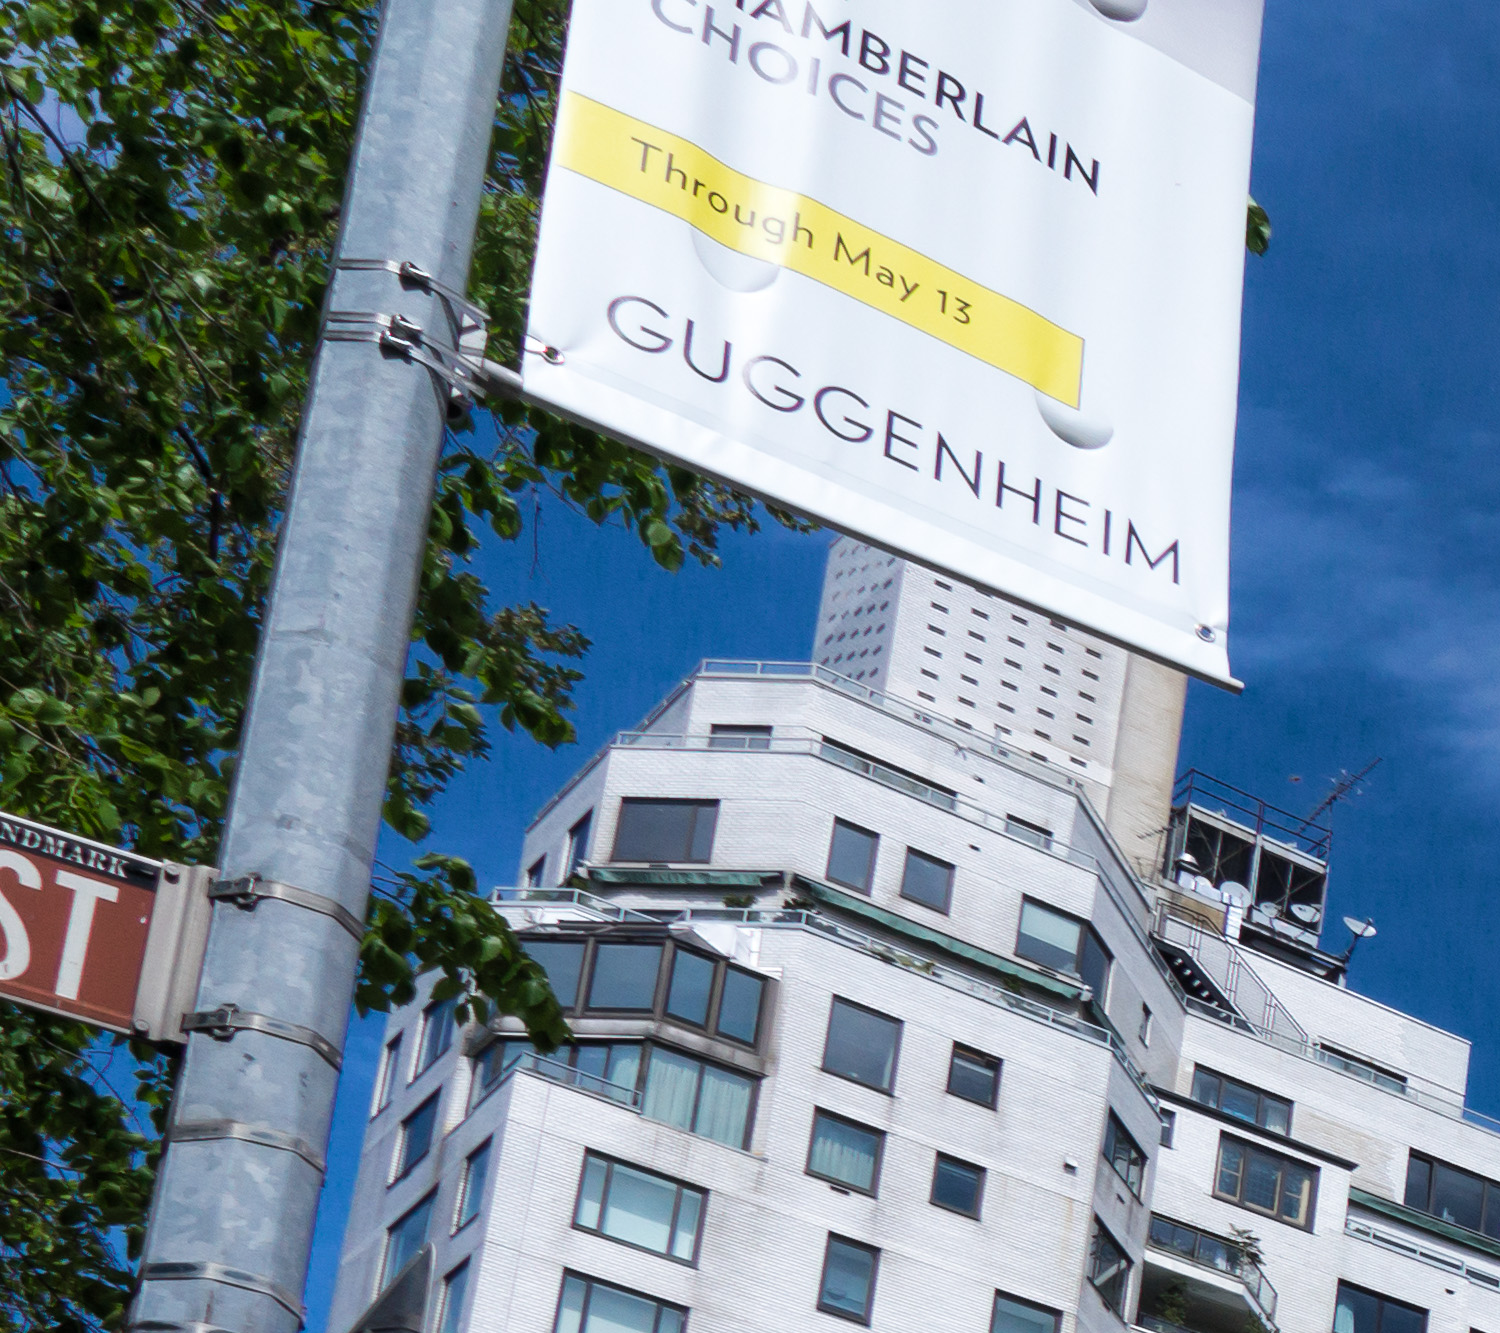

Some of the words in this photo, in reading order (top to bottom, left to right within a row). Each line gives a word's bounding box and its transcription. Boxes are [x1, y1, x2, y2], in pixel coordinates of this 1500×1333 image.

[650, 0, 938, 156] CHOICES
[736, 0, 1100, 197] AMBERLAIN
[631, 136, 814, 248] Through
[833, 231, 919, 302] May
[936, 289, 973, 327] 13
[607, 295, 1181, 585] GUGGENHEIM
